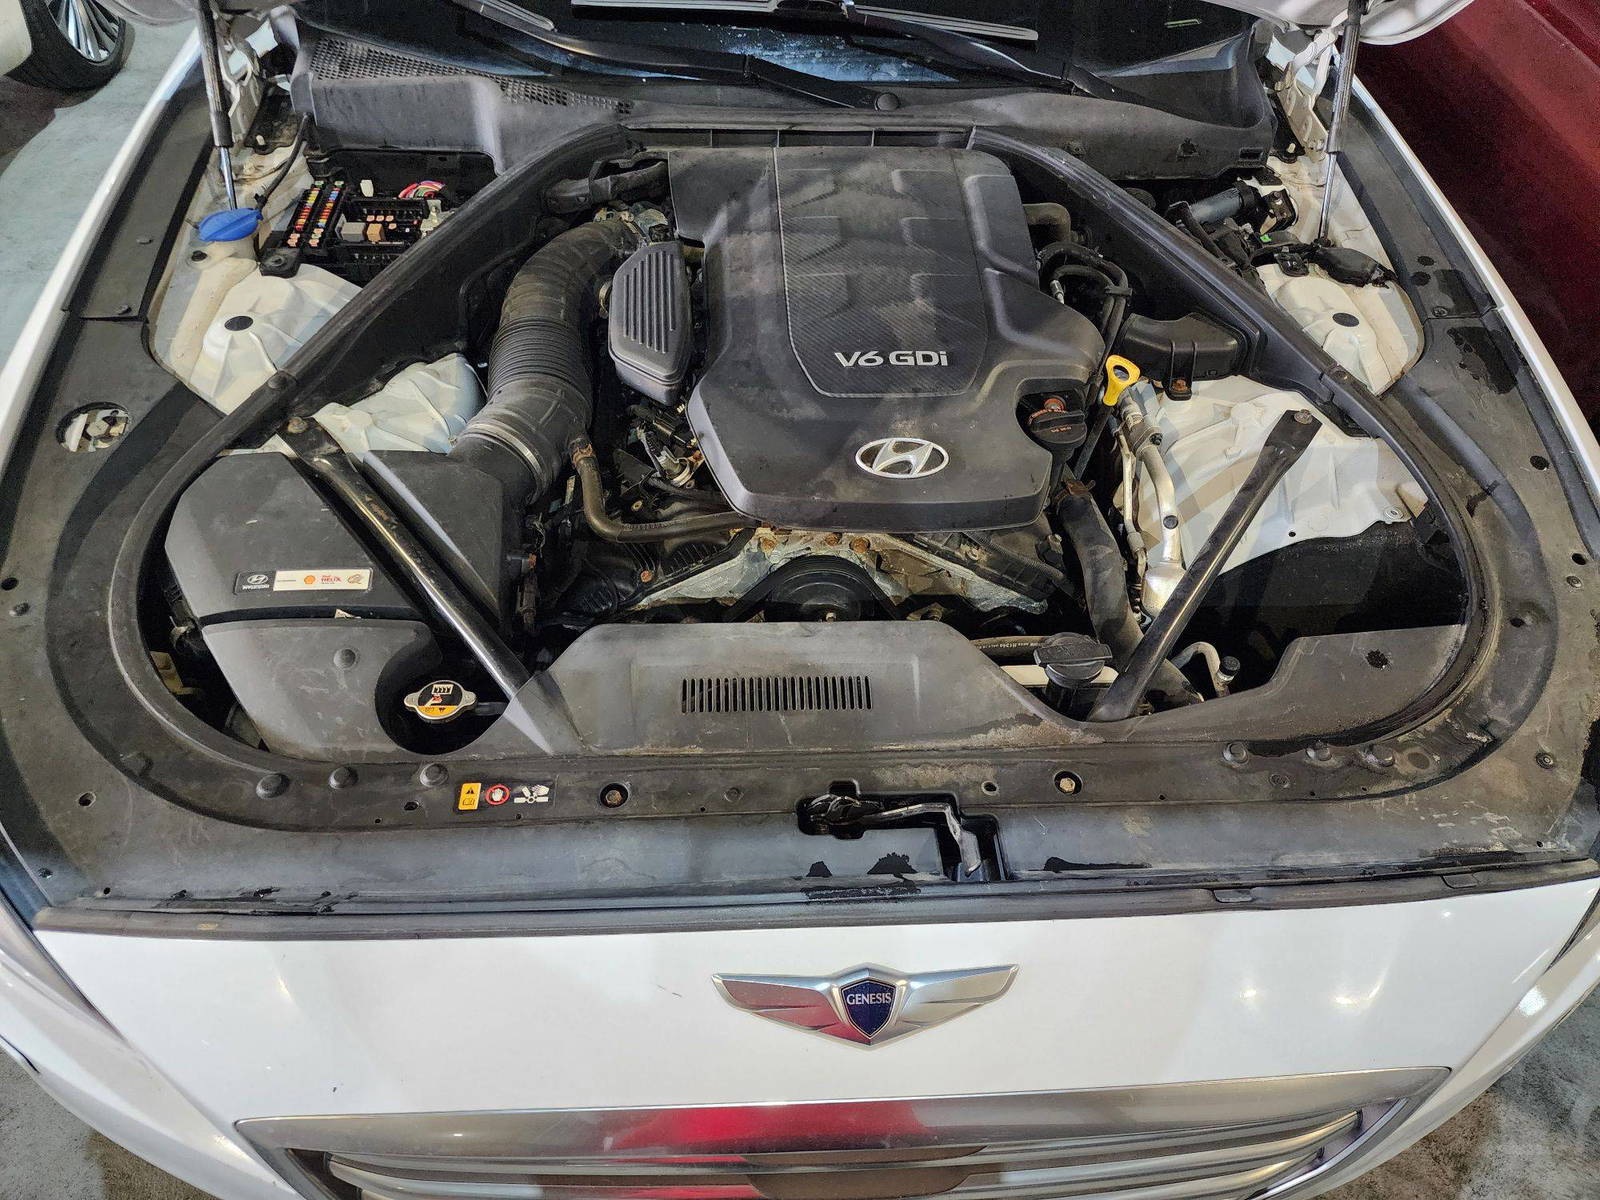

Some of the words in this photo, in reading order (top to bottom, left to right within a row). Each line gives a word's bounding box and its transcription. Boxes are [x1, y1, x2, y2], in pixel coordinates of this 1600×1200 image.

[834, 350, 884, 367] V6
[889, 350, 948, 366] GDi
[846, 992, 892, 1005] GENESIS
